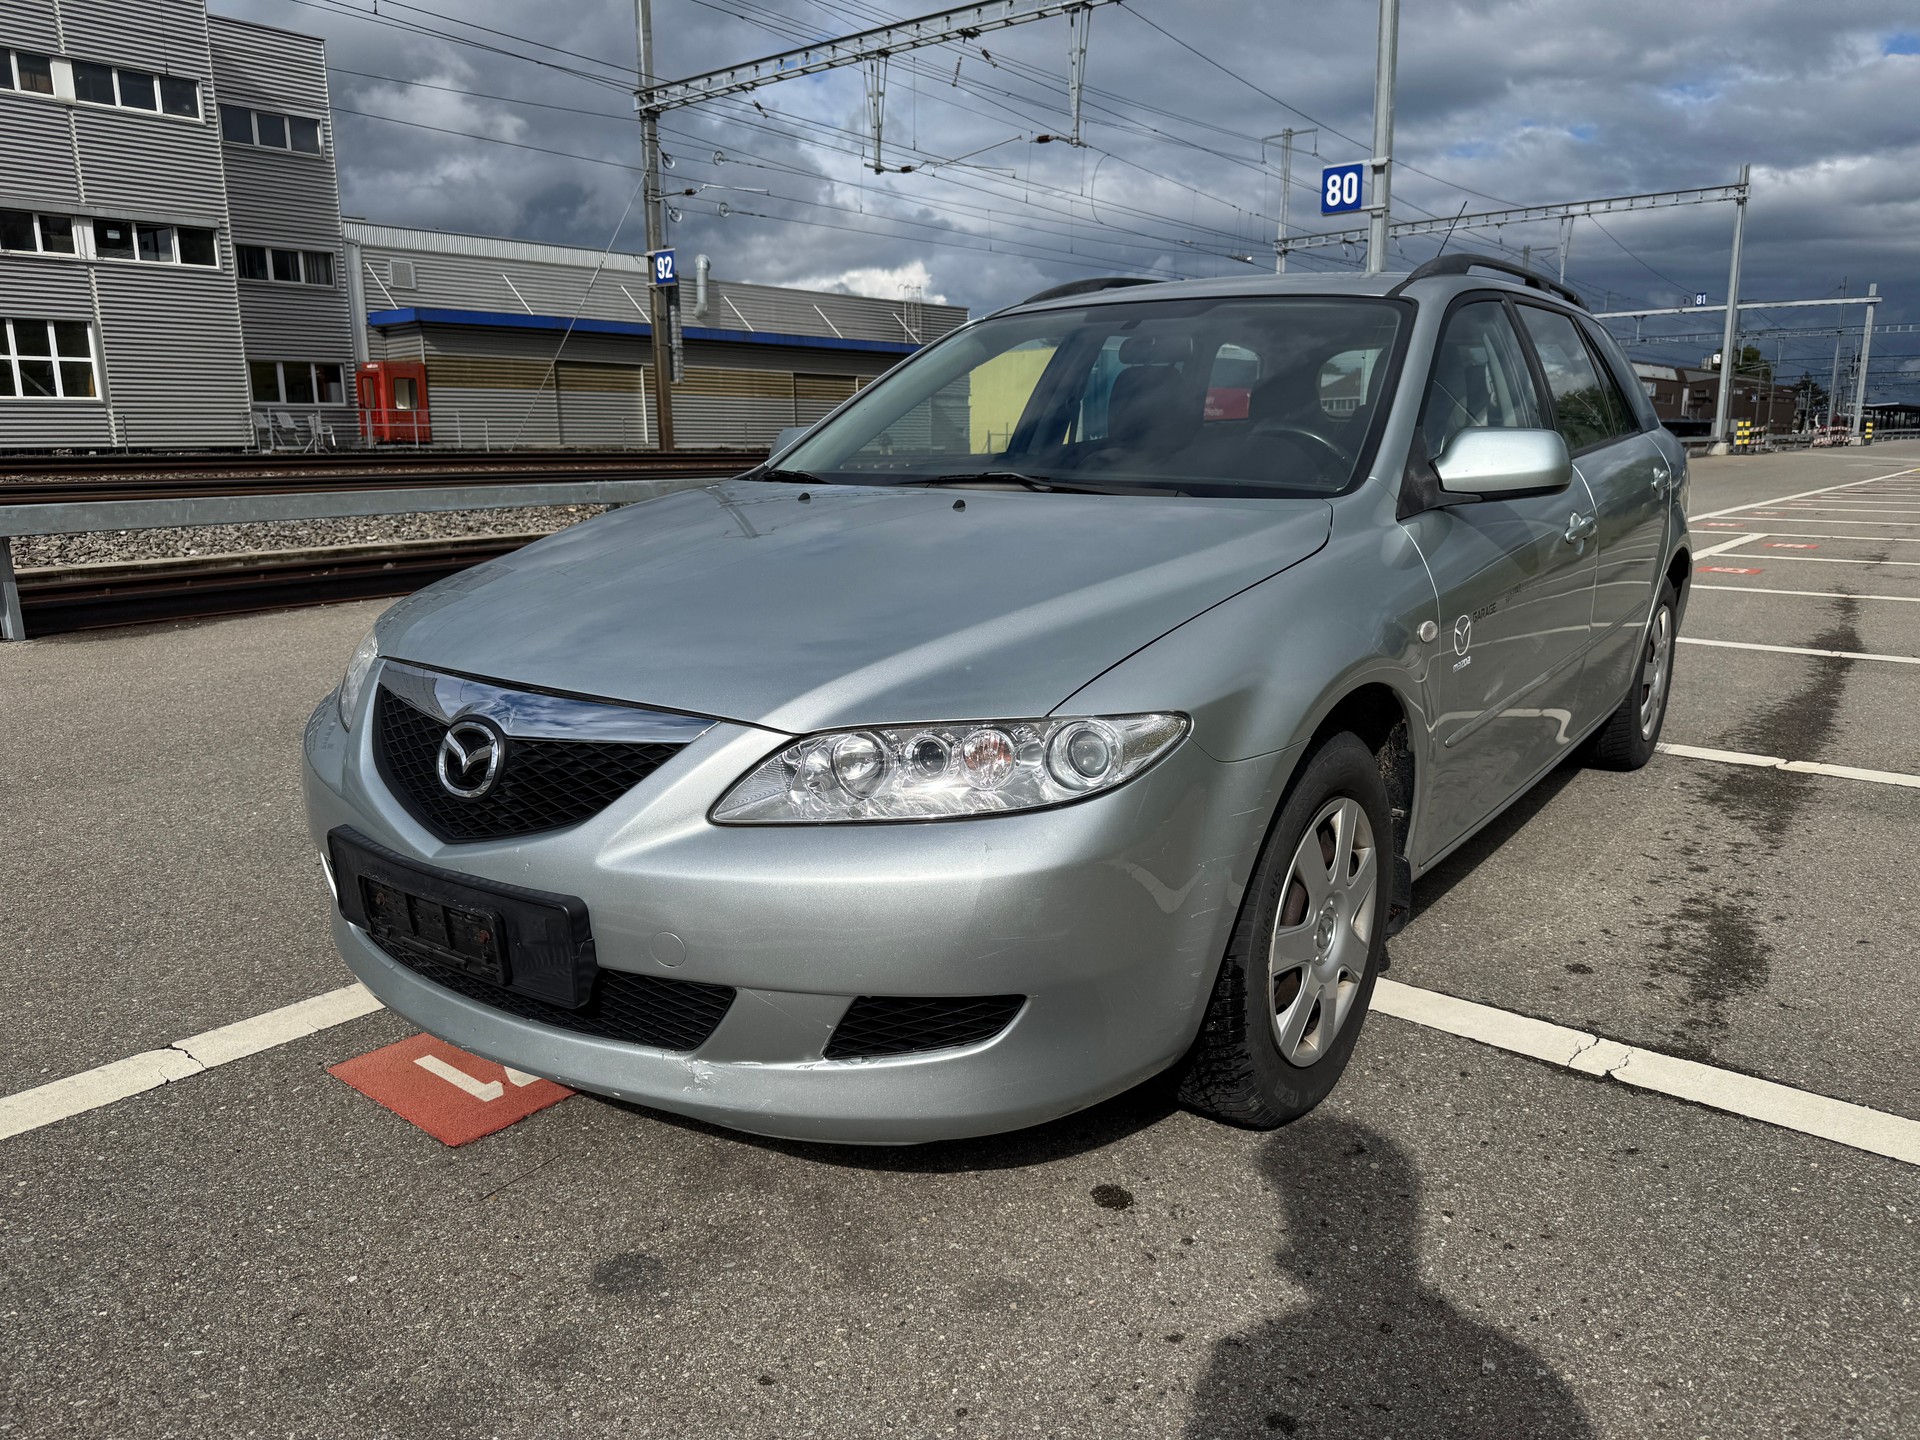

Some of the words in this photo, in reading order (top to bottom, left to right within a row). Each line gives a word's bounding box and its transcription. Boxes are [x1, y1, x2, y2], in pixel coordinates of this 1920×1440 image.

[1326, 172, 1358, 206] 80
[657, 256, 673, 279] 92
[1696, 294, 1706, 304] 81
[1473, 602, 1497, 623] GARAGE
